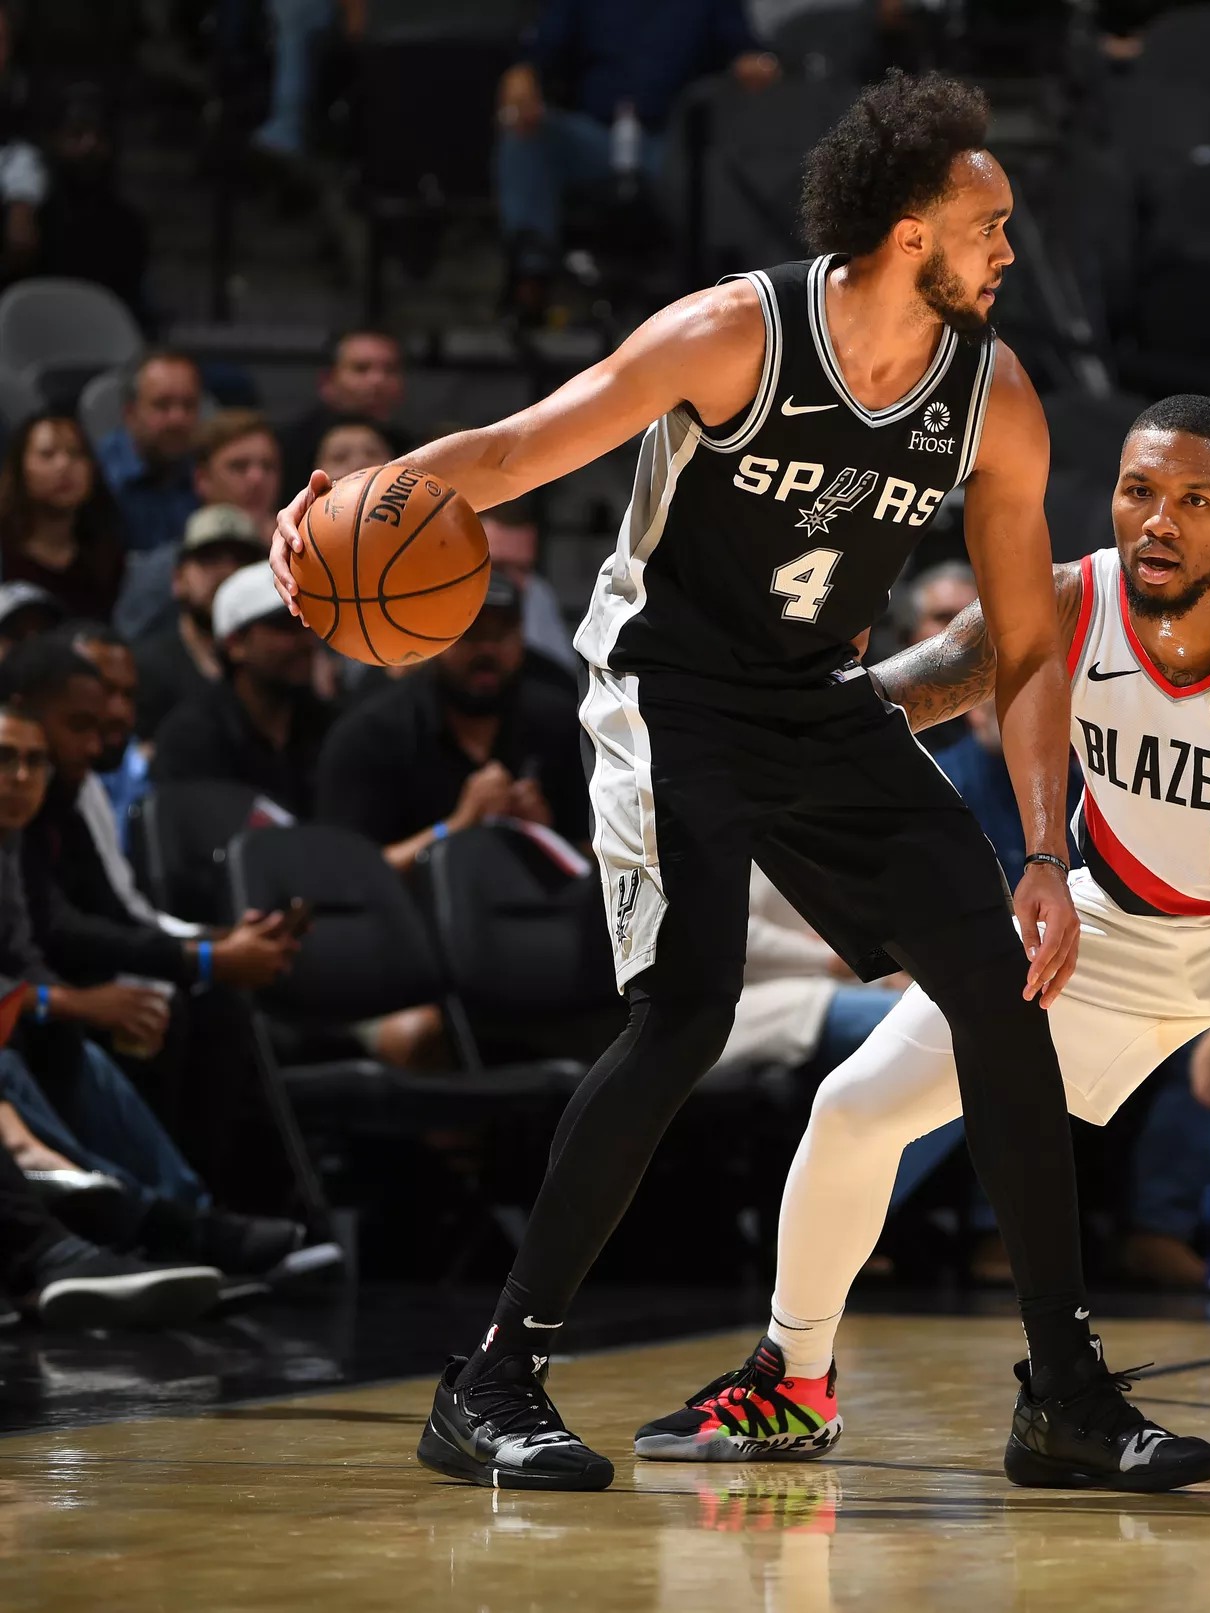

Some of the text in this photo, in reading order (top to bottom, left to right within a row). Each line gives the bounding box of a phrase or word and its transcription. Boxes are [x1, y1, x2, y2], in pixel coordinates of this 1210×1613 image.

[907, 430, 956, 455] Frost
[367, 469, 427, 528] LDING
[733, 454, 945, 538] SPURS
[770, 547, 844, 624] 4
